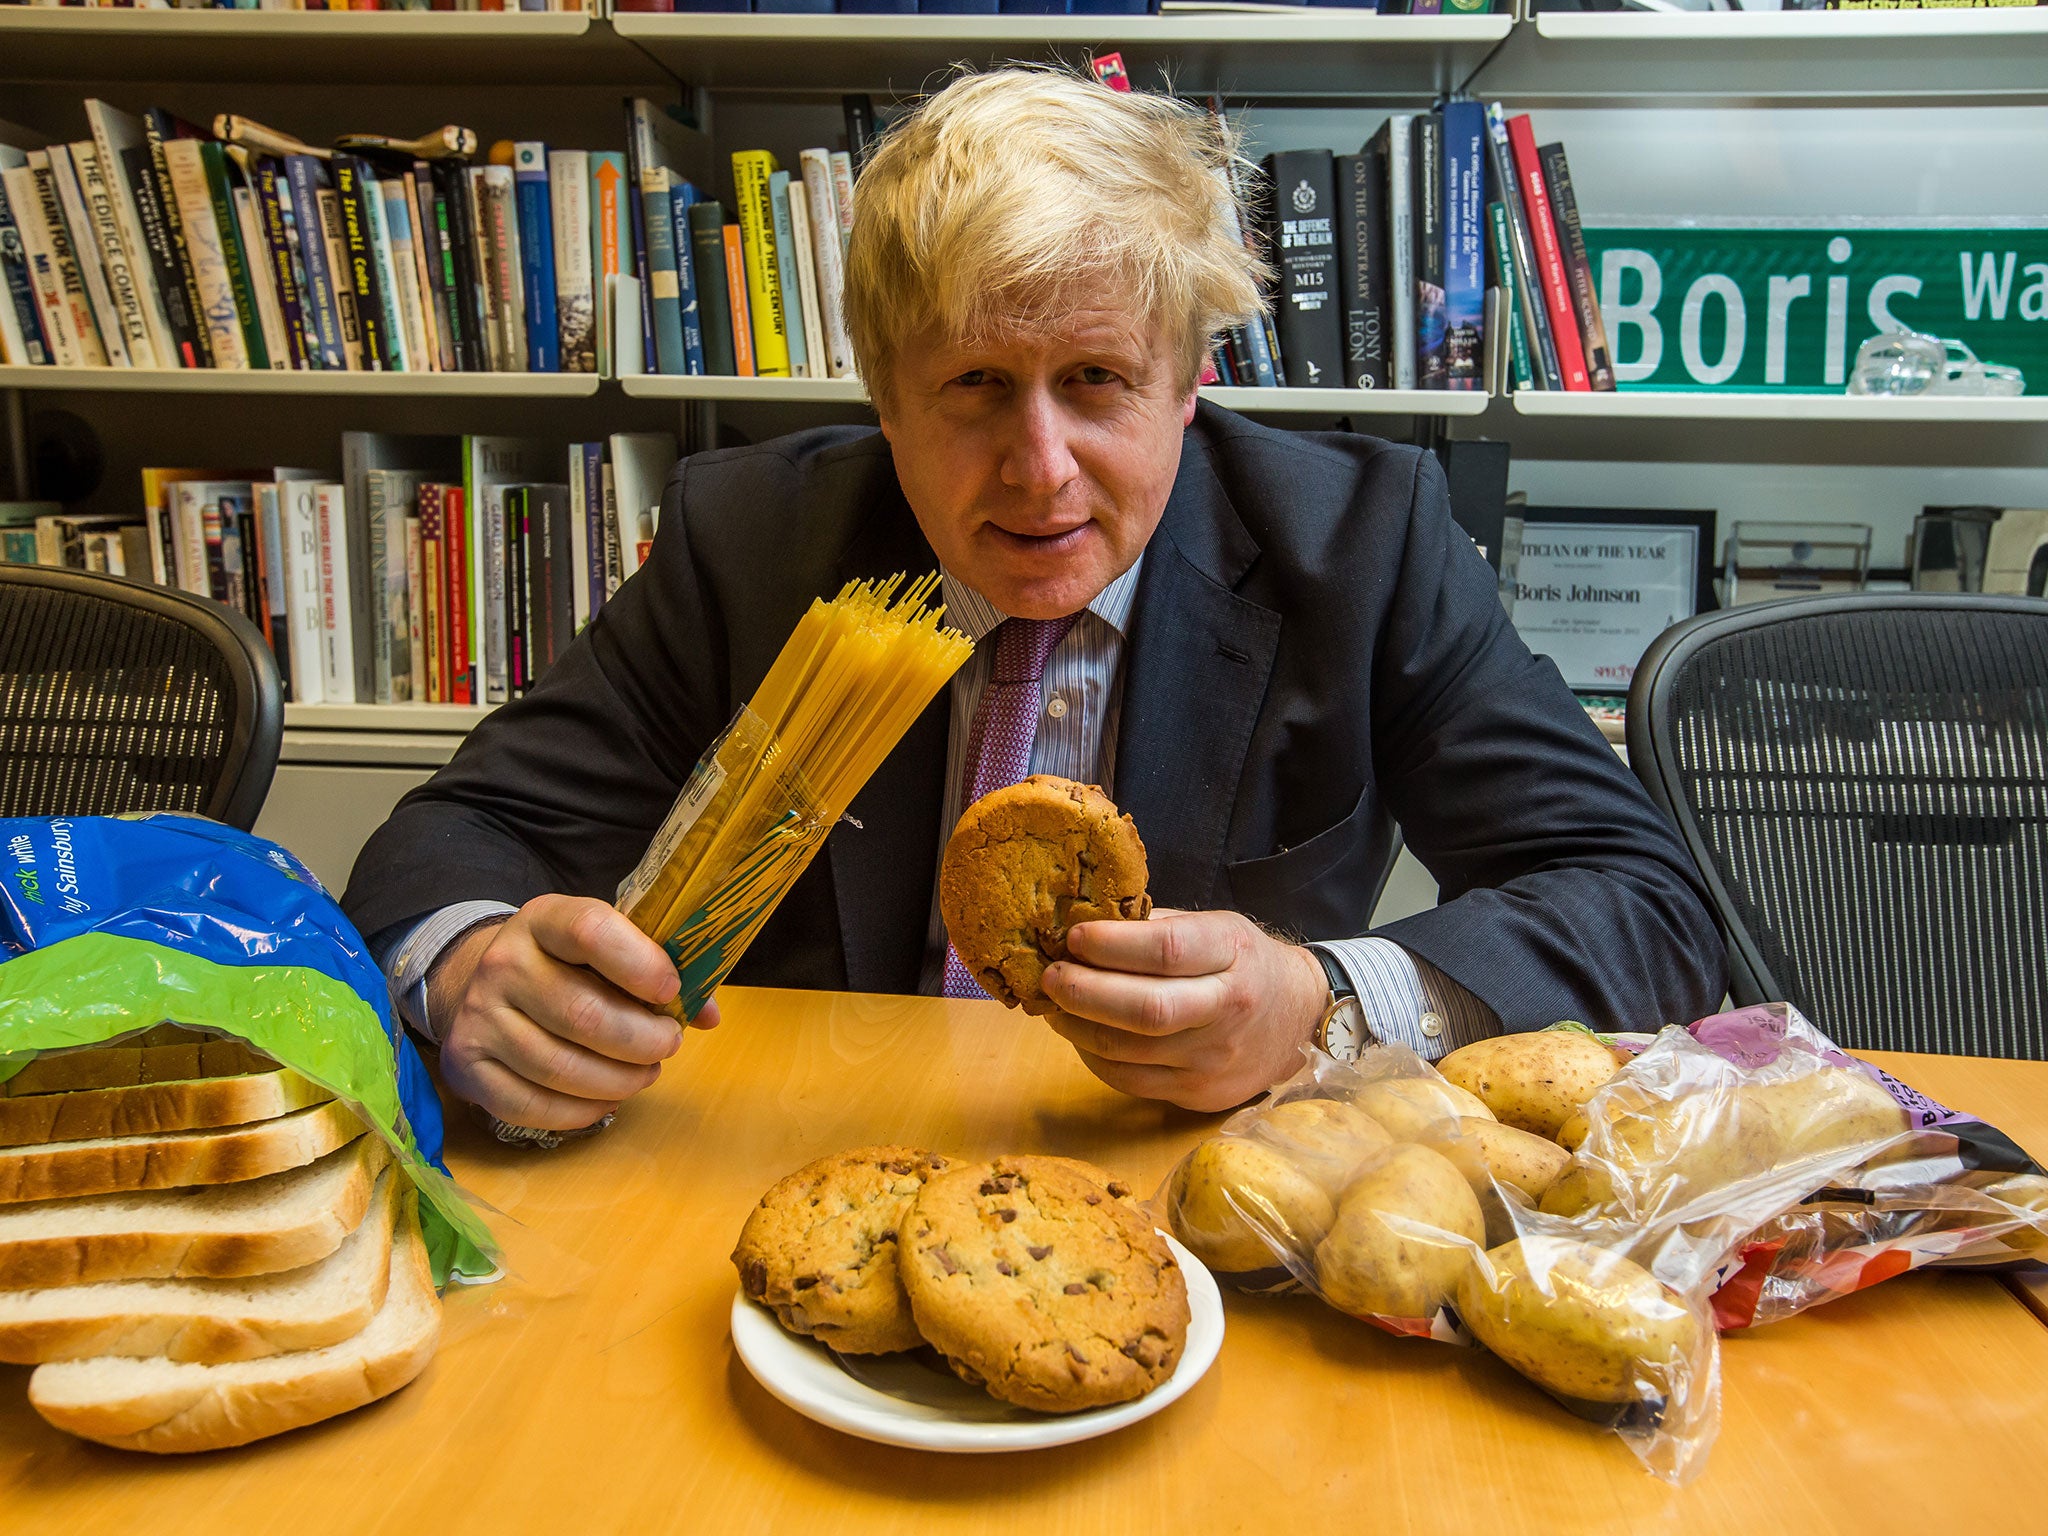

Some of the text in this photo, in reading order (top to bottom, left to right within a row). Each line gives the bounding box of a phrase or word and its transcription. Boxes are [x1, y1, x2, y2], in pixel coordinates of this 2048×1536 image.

[261, 170, 276, 194] The
[734, 162, 748, 199] James
[1462, 170, 1472, 200] Games
[1553, 153, 1573, 191] JACK
[674, 199, 685, 215] The
[739, 203, 752, 244] Martin
[1450, 201, 1459, 234] LONDON
[1462, 202, 1472, 218] and
[1469, 136, 1481, 288] The Official History of the Olympic
[34, 168, 59, 226] BRITAIN
[48, 228, 68, 260] FOR
[60, 261, 82, 297] SALE
[338, 167, 371, 297] The Israeli Codes
[604, 208, 616, 246] Rational
[675, 217, 687, 253] Classics
[1282, 220, 1298, 234] THE
[1354, 161, 1370, 300] ON THE CONTRARY
[1462, 220, 1472, 234] the
[1536, 207, 1553, 252] Celebration
[82, 154, 146, 342] THE EDIFICE COMPLEX
[755, 161, 785, 337] THE MEANING OF THE CENTURY
[1295, 272, 1324, 287] MI5
[1549, 263, 1562, 285] Many
[1553, 286, 1567, 313] Voices
[1600, 236, 1923, 386] Boris
[1349, 310, 1365, 361] LEON
[1363, 306, 1382, 361] TONY
[490, 503, 504, 548] GERALD
[588, 454, 604, 578] Treasures of Botanical Art
[604, 488, 620, 579] BUILDING TITANIC
[322, 545, 333, 576] RULED
[1573, 545, 1594, 559] OF
[1597, 546, 1625, 560] THE
[1626, 547, 1666, 561] YEAR
[323, 578, 334, 594] THE
[1515, 583, 1641, 603] Boris Johnson
[324, 597, 337, 631] WORLD
[7, 834, 37, 864] white
[58, 894, 92, 915] by
